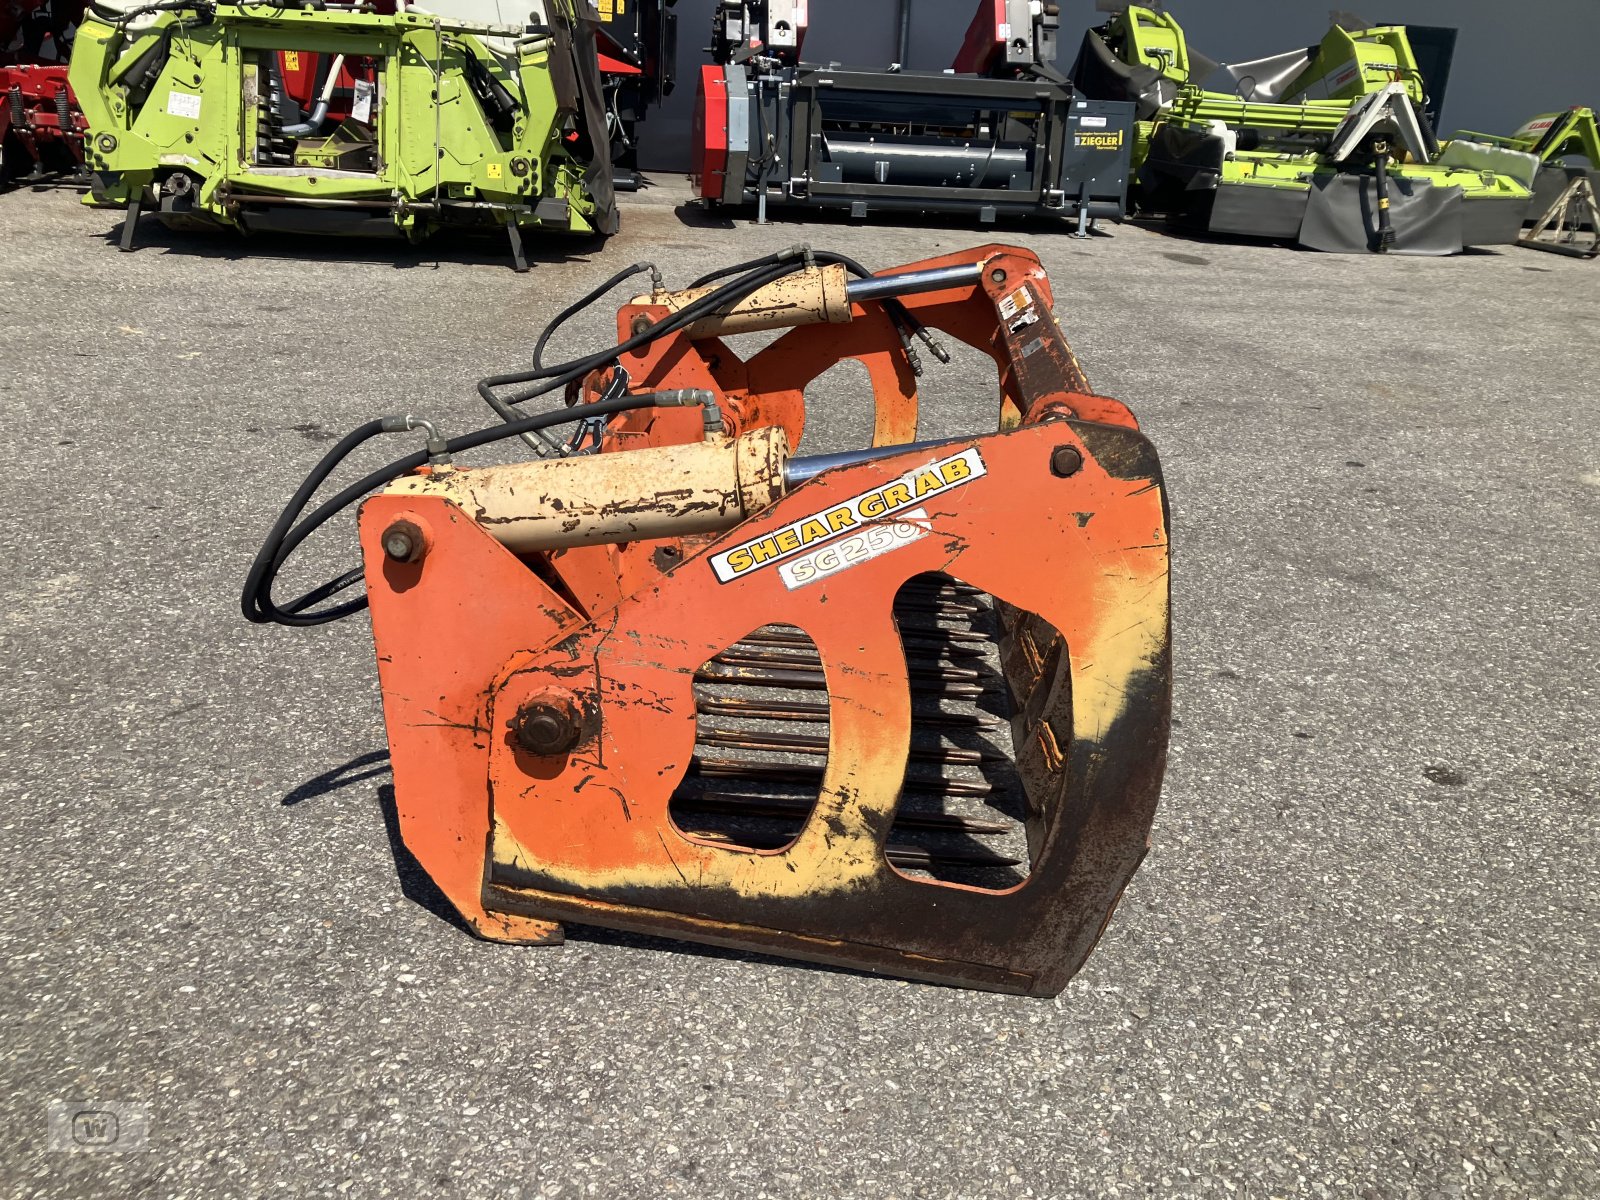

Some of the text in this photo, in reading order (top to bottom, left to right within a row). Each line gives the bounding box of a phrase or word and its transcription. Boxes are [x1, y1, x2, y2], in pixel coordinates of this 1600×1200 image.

[1080, 136, 1118, 146] ZIEGLER
[726, 457, 972, 573] SHEAR GRAB
